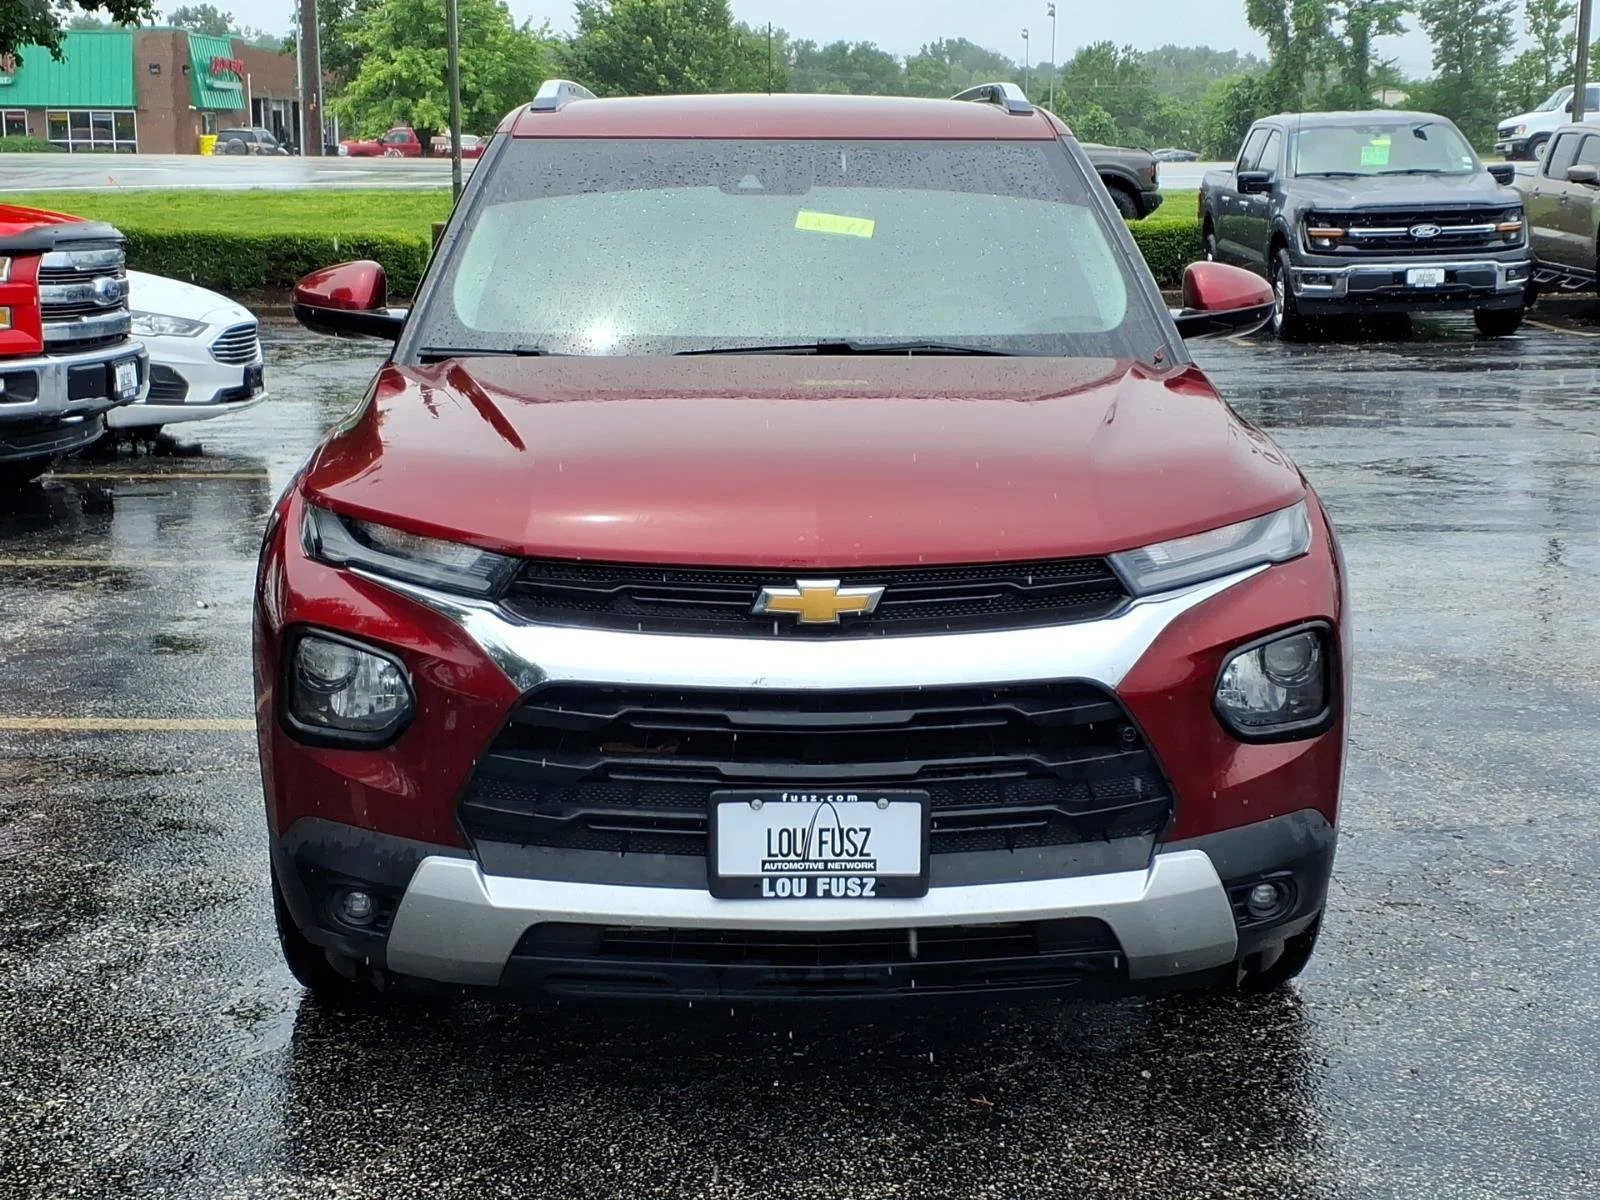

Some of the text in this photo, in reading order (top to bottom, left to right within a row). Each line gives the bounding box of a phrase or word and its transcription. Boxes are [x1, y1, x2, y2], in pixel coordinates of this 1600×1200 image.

[1415, 226, 1437, 236] Ford
[782, 792, 858, 802] fusz.com
[767, 827, 872, 858] LOU FUSZ
[763, 862, 875, 870] AUTOMOTIVE NETWORK
[762, 878, 876, 897] LOU FUSZ
